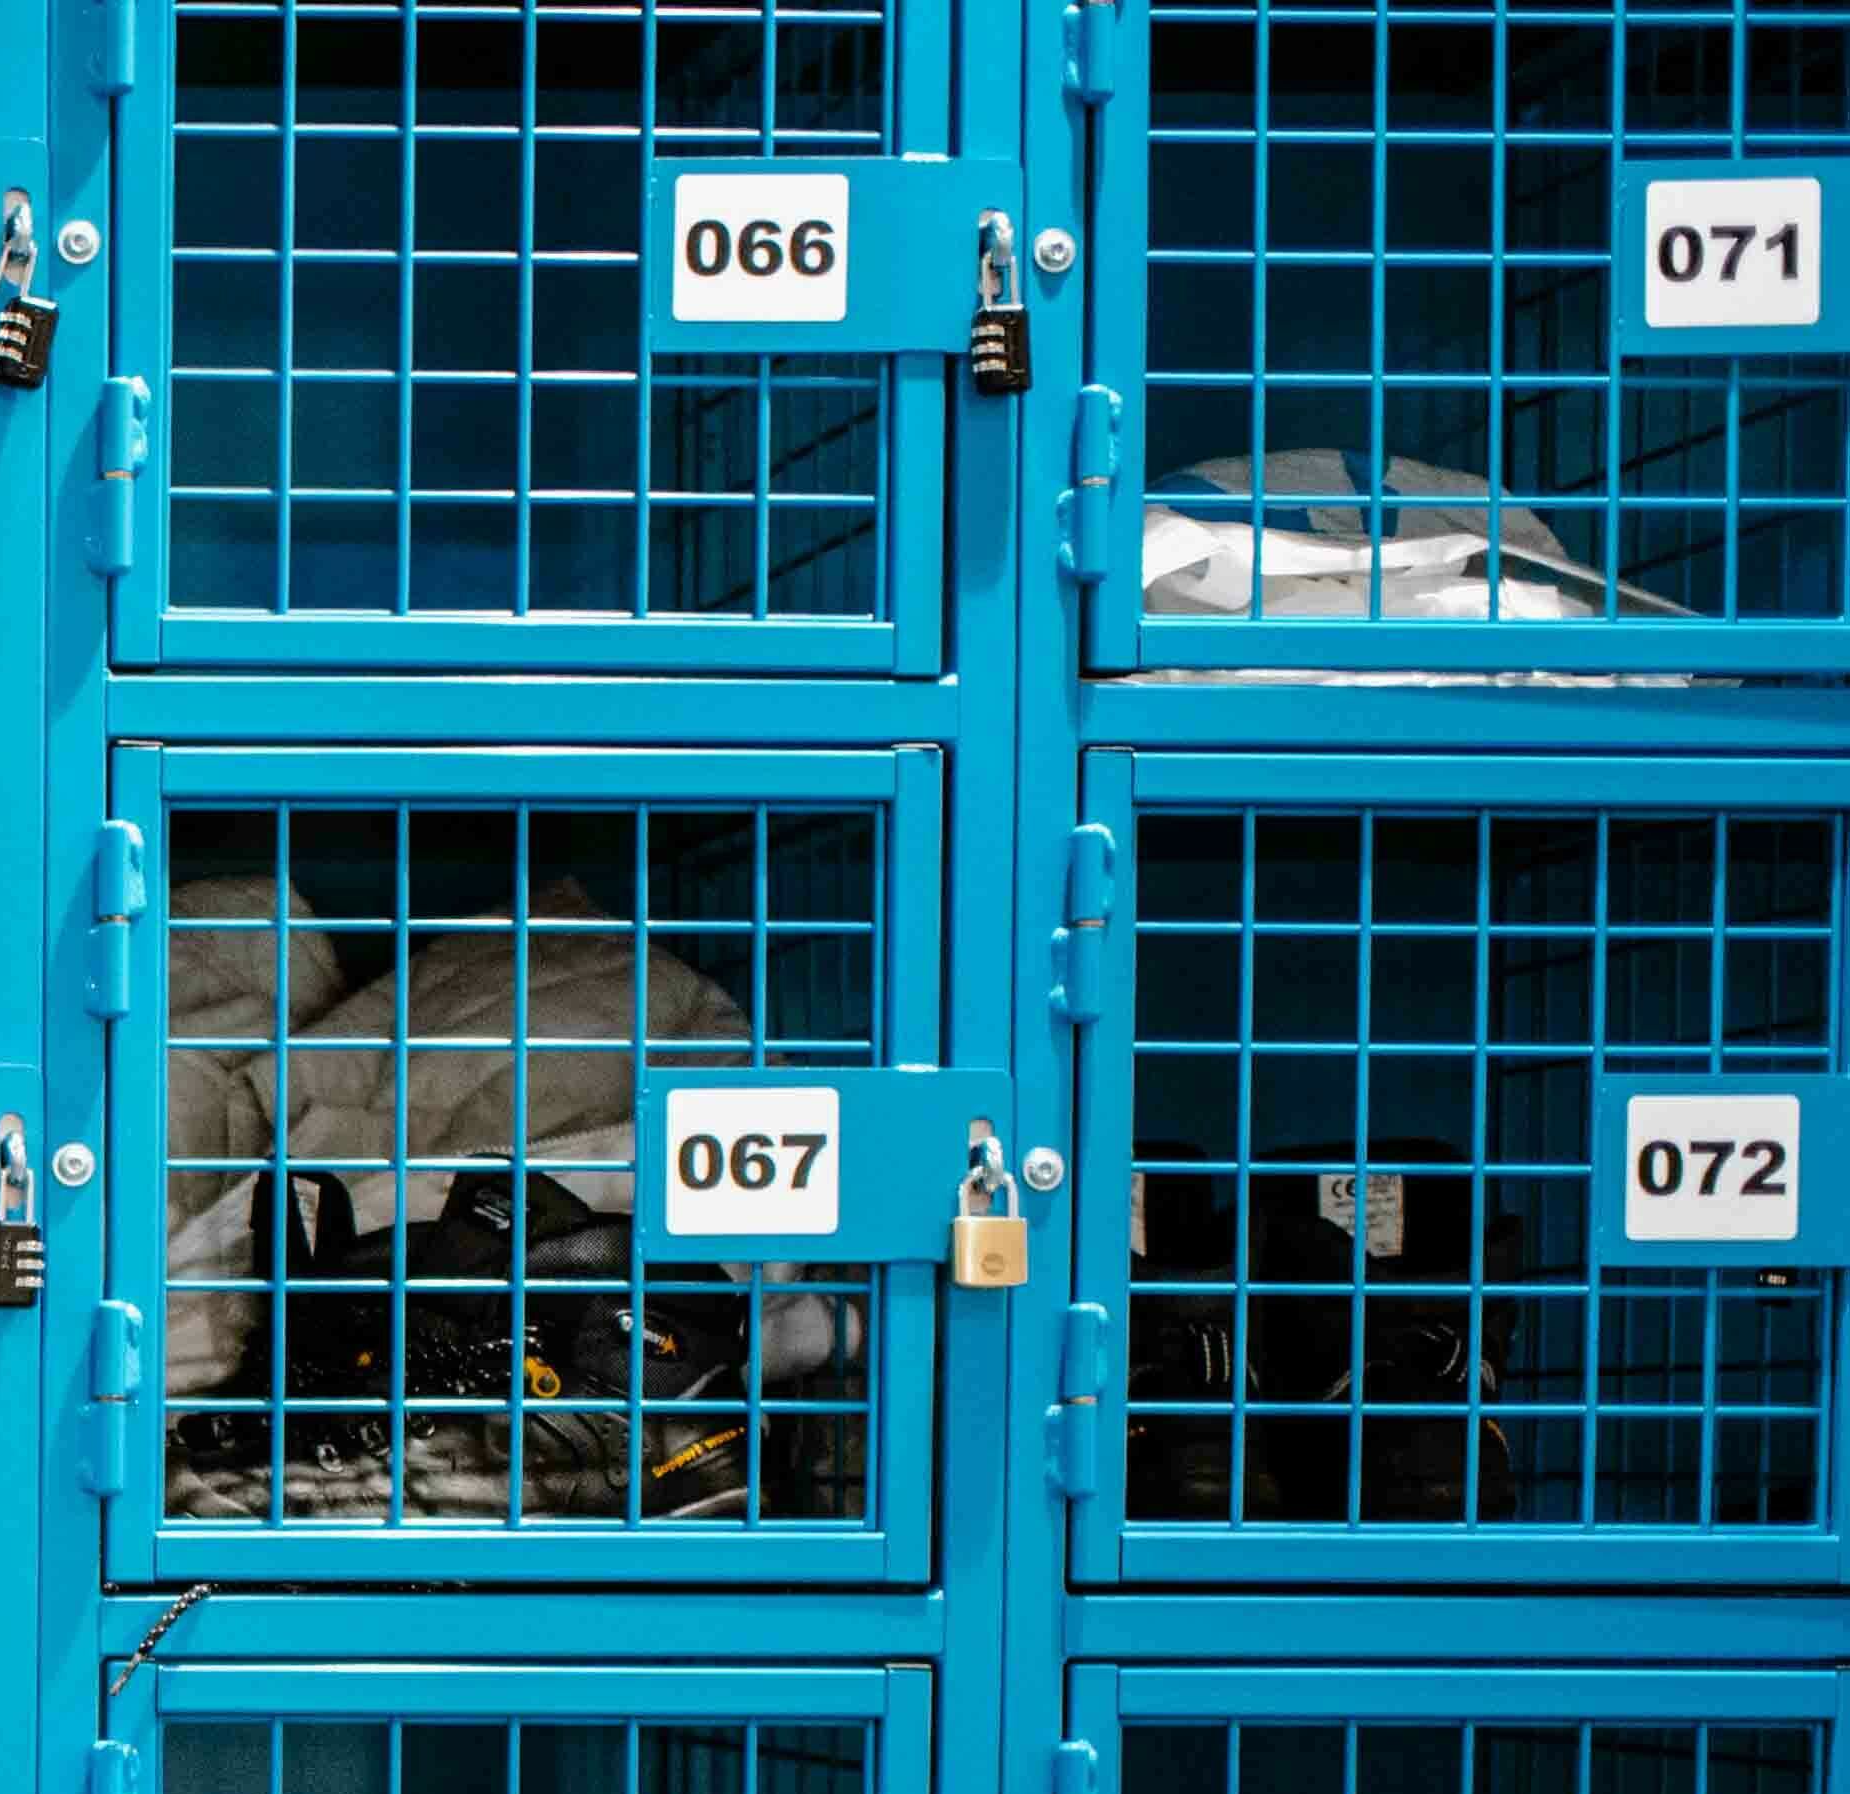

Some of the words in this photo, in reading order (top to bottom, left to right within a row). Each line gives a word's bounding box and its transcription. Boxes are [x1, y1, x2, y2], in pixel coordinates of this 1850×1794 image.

[685, 219, 835, 277] 066
[1657, 224, 1798, 283] 071
[677, 1133, 827, 1190] 067
[1637, 1139, 1787, 1197] 072
